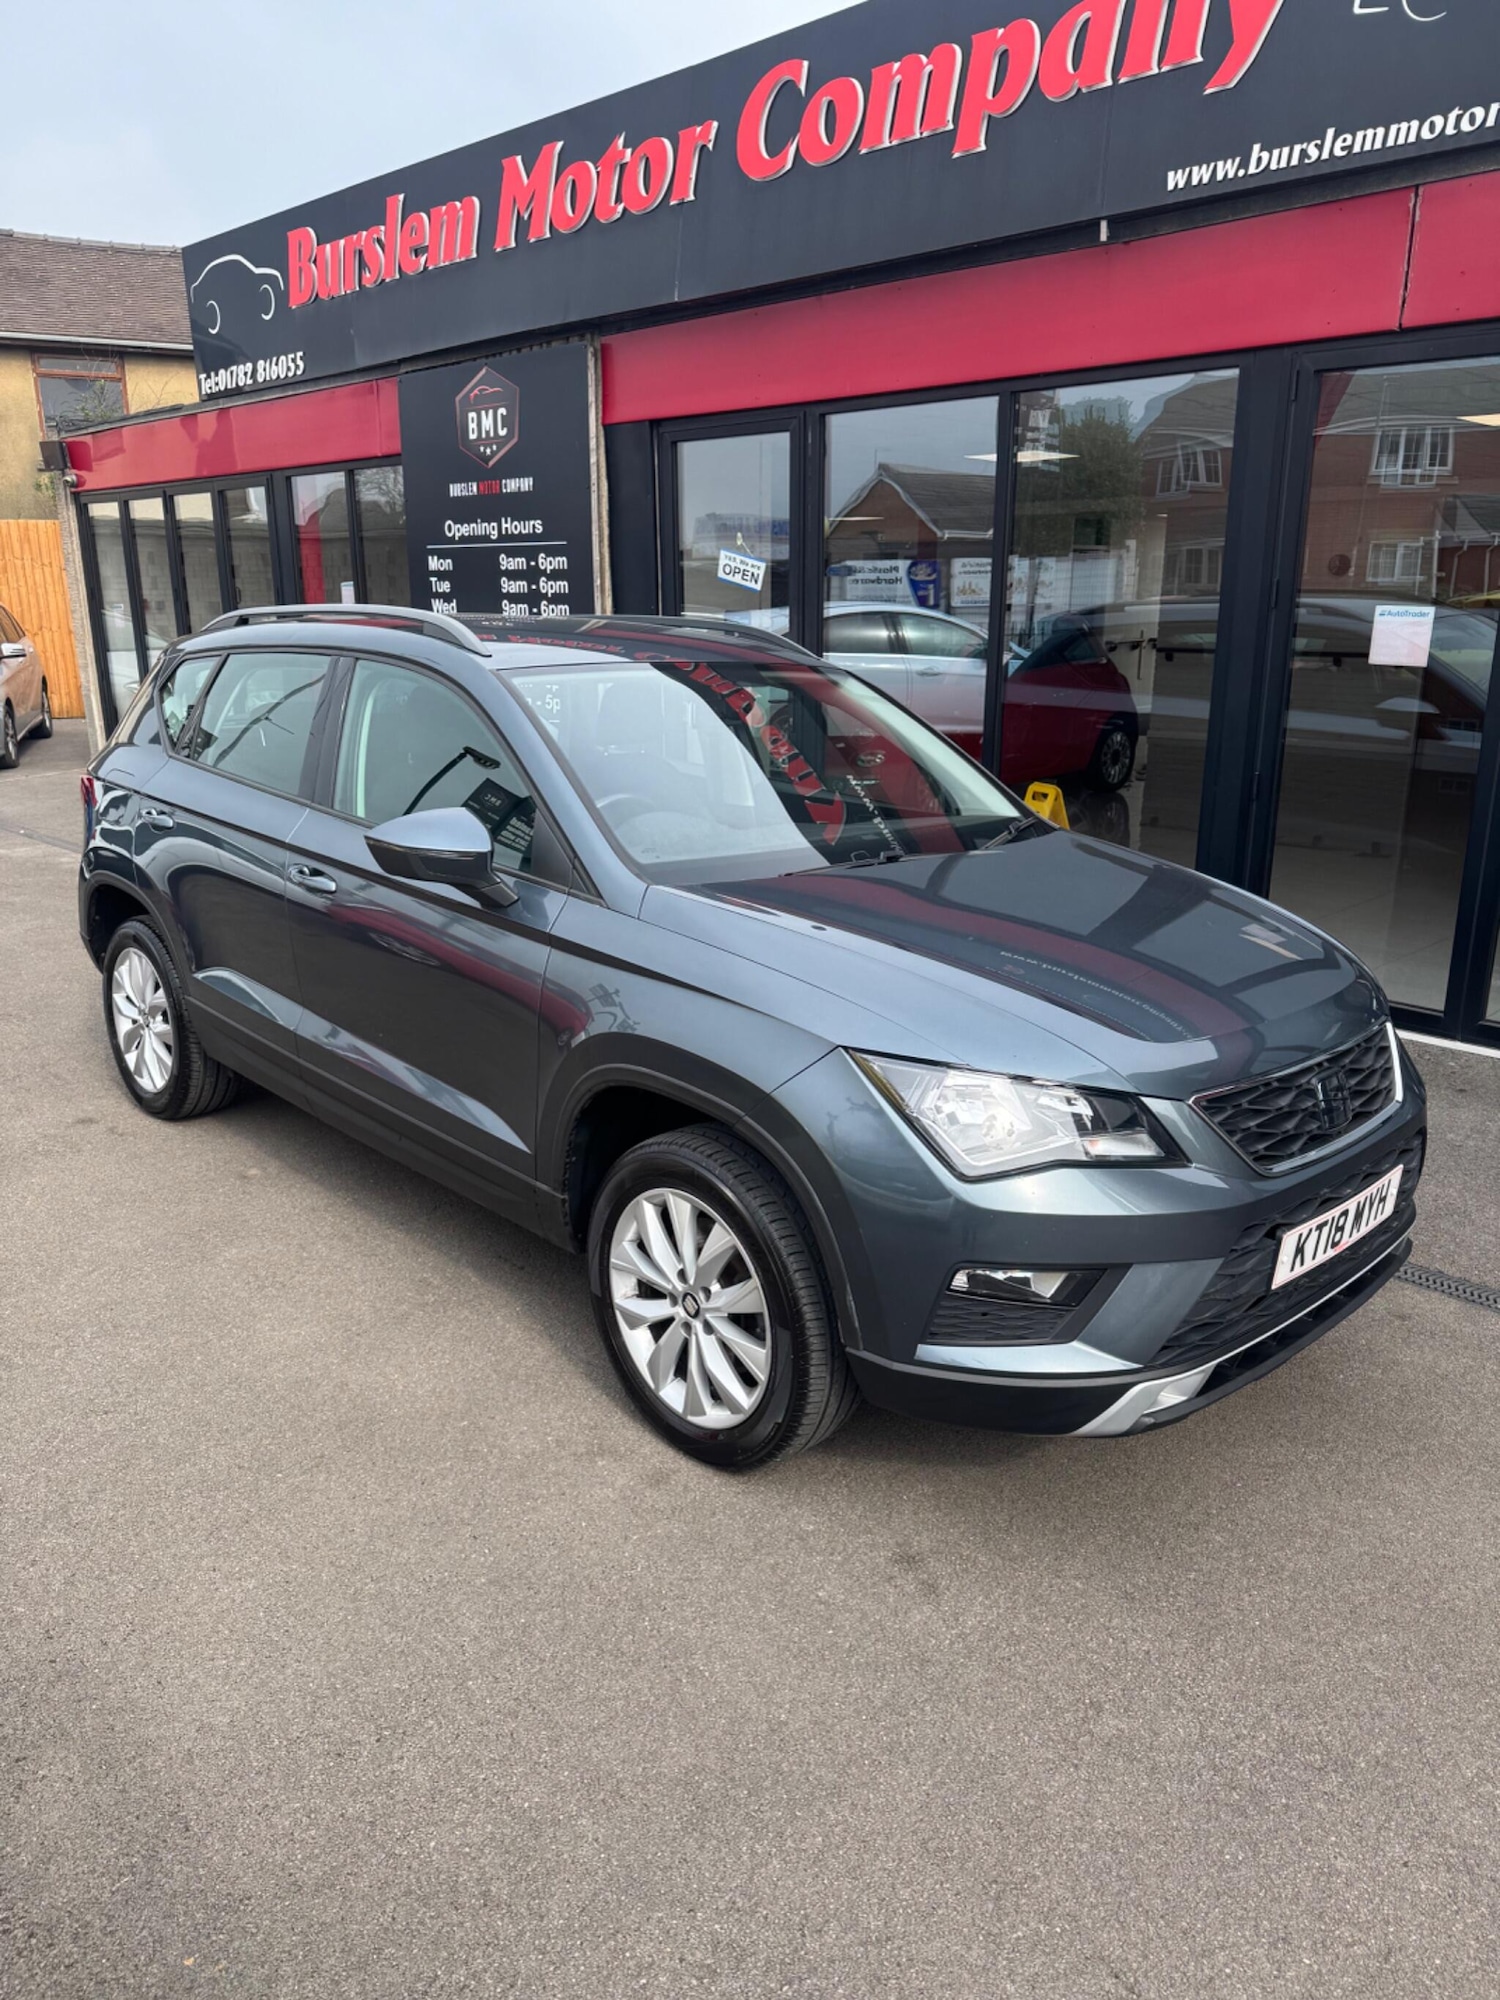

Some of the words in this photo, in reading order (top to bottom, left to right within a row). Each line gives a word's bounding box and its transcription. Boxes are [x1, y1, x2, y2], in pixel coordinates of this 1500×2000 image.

[287, 193, 479, 308] Burslem
[494, 119, 718, 252] Motor
[199, 362, 253, 395] Tel:01782
[256, 351, 304, 383] 816055
[468, 407, 508, 440] BMC
[478, 479, 500, 495] MOTOR
[501, 476, 534, 493] COMPANY
[444, 519, 498, 541] Opening
[501, 517, 543, 535] Hours
[427, 555, 453, 571] Mon
[499, 553, 527, 570] 9am
[538, 553, 568, 574] 6pm
[722, 563, 760, 585] OPEN
[429, 577, 451, 593] Tue
[500, 577, 528, 593] 9am
[539, 577, 569, 597] 6pm
[431, 599, 457, 615] Wed
[501, 600, 529, 616] 9am
[540, 601, 570, 616] 6pm
[1289, 1208, 1350, 1273] KT18
[1349, 1178, 1392, 1239] MYH
